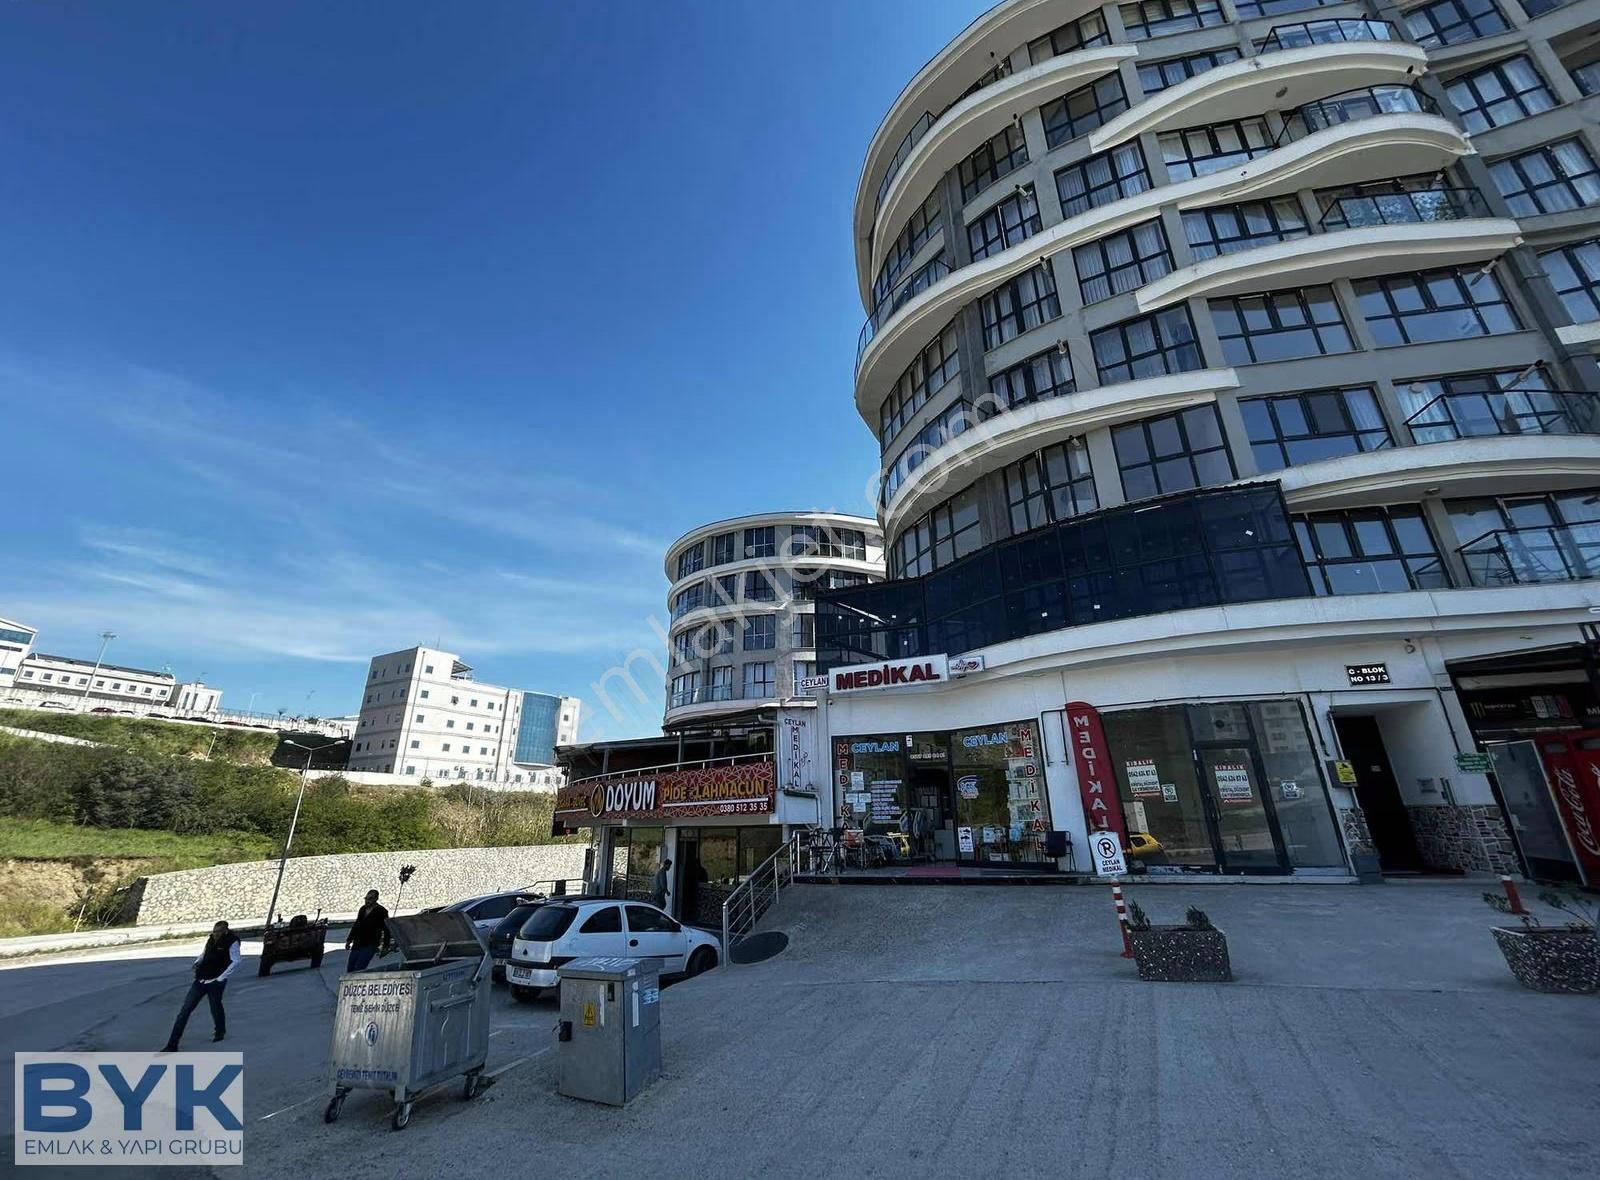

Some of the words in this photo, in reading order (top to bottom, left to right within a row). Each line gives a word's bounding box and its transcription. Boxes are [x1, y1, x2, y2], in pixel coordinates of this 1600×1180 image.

[801, 677, 828, 688] CEYLAN
[835, 663, 940, 691] MEDİKAL
[784, 717, 806, 728] CEYLAN
[963, 731, 1008, 747] CEYLAN
[851, 741, 899, 754] CEYLAN
[792, 726, 800, 788] MEDİKAL
[606, 781, 655, 812] DOYUM
[663, 782, 687, 800] PİDE
[695, 781, 765, 800] LAHMACUN
[343, 983, 367, 997] DÜZCE
